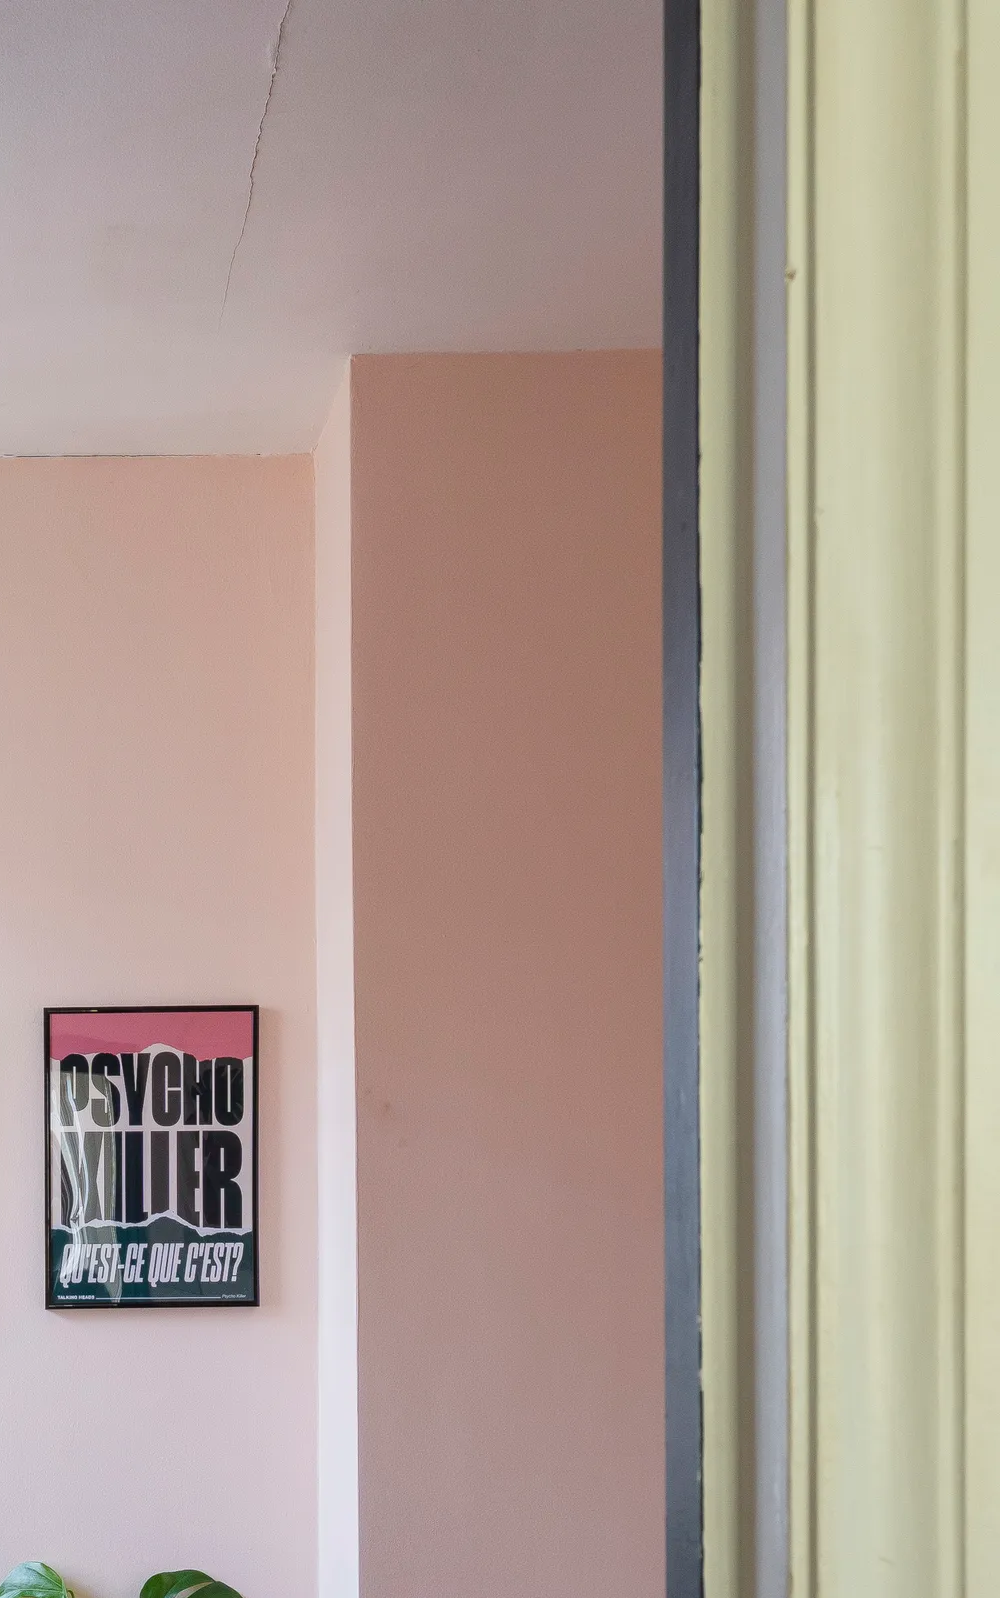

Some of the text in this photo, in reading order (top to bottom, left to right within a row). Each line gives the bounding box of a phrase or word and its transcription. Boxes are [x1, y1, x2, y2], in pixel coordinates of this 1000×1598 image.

[60, 1051, 244, 1128] PSYCHO
[60, 1130, 242, 1229] KILLER
[148, 1242, 184, 1287] QUE
[184, 1242, 244, 1283] C'EST?
